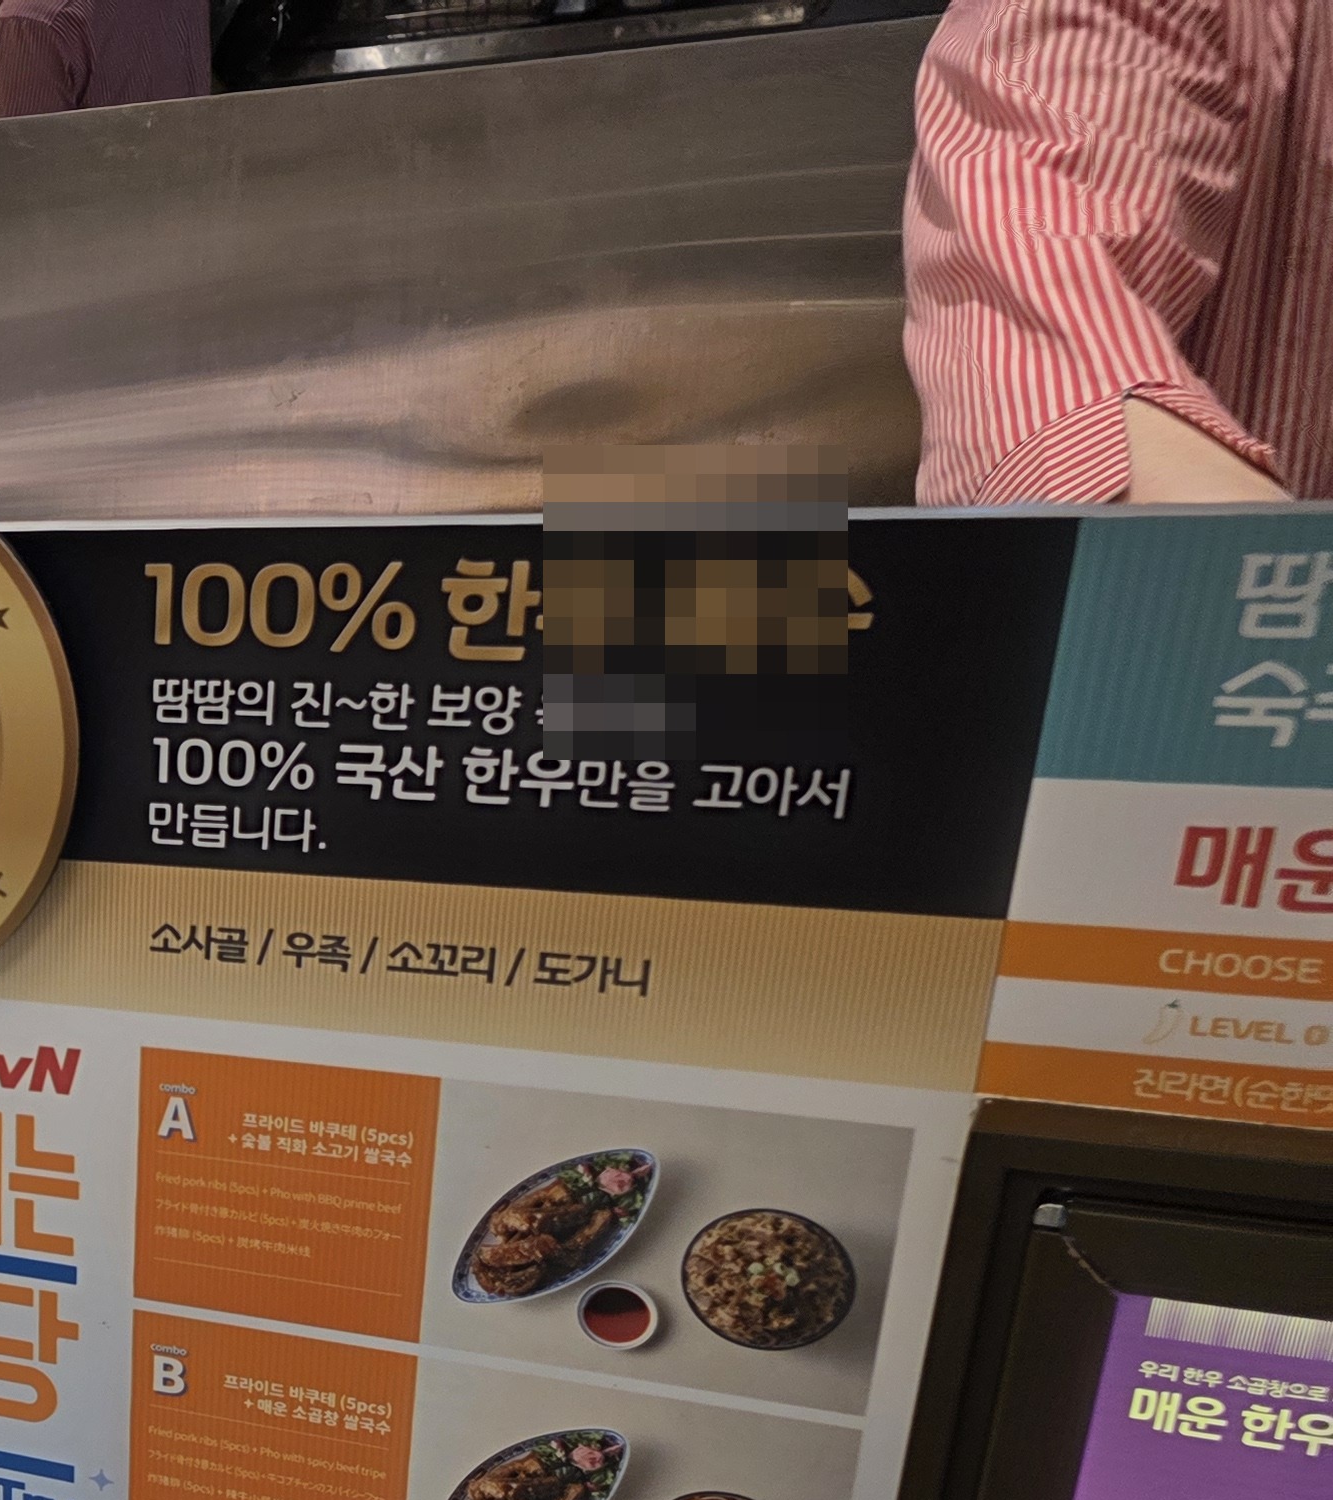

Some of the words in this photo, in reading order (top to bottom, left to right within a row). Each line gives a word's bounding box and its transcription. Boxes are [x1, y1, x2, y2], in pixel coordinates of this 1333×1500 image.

[144, 560, 418, 654] 100%
[151, 677, 276, 728] 땀땀의
[290, 680, 415, 731] 진~한
[427, 684, 522, 737] 보양
[151, 737, 315, 793] 100%
[334, 743, 444, 802] 국산
[462, 747, 676, 815] 한우만을
[693, 762, 851, 821] 고아서
[148, 802, 328, 853] 만듭니다.
[150, 922, 248, 966] 소사골
[282, 931, 353, 973] 우족
[387, 939, 498, 984] 소꼬리
[534, 951, 652, 998] 도가니
[1158, 948, 1324, 983] CHOOSE
[1188, 1015, 1295, 1045] LEVEL
[159, 1083, 196, 1095] combo
[157, 1096, 195, 1141] A
[243, 1112, 305, 1133] 프라이드
[309, 1120, 357, 1141] 바쿠테
[361, 1126, 414, 1150] (5pcs)
[277, 1136, 307, 1155] 직화
[311, 1139, 358, 1162] 소고기
[363, 1146, 412, 1168] 쌀국수
[150, 1343, 187, 1356] combo
[153, 1355, 186, 1394] B
[1138, 1360, 1180, 1382] 우리
[1183, 1367, 1223, 1388] 한우
[1226, 1374, 1330, 1402] 소곱창으로
[223, 1374, 285, 1398] 프라이드
[289, 1385, 336, 1407] 바쿠테
[340, 1394, 392, 1419] (5pcs)
[257, 1399, 288, 1418] 매운
[292, 1405, 339, 1427] 소곱창
[343, 1413, 392, 1436] 쌀국수
[1129, 1388, 1229, 1441] 매운
